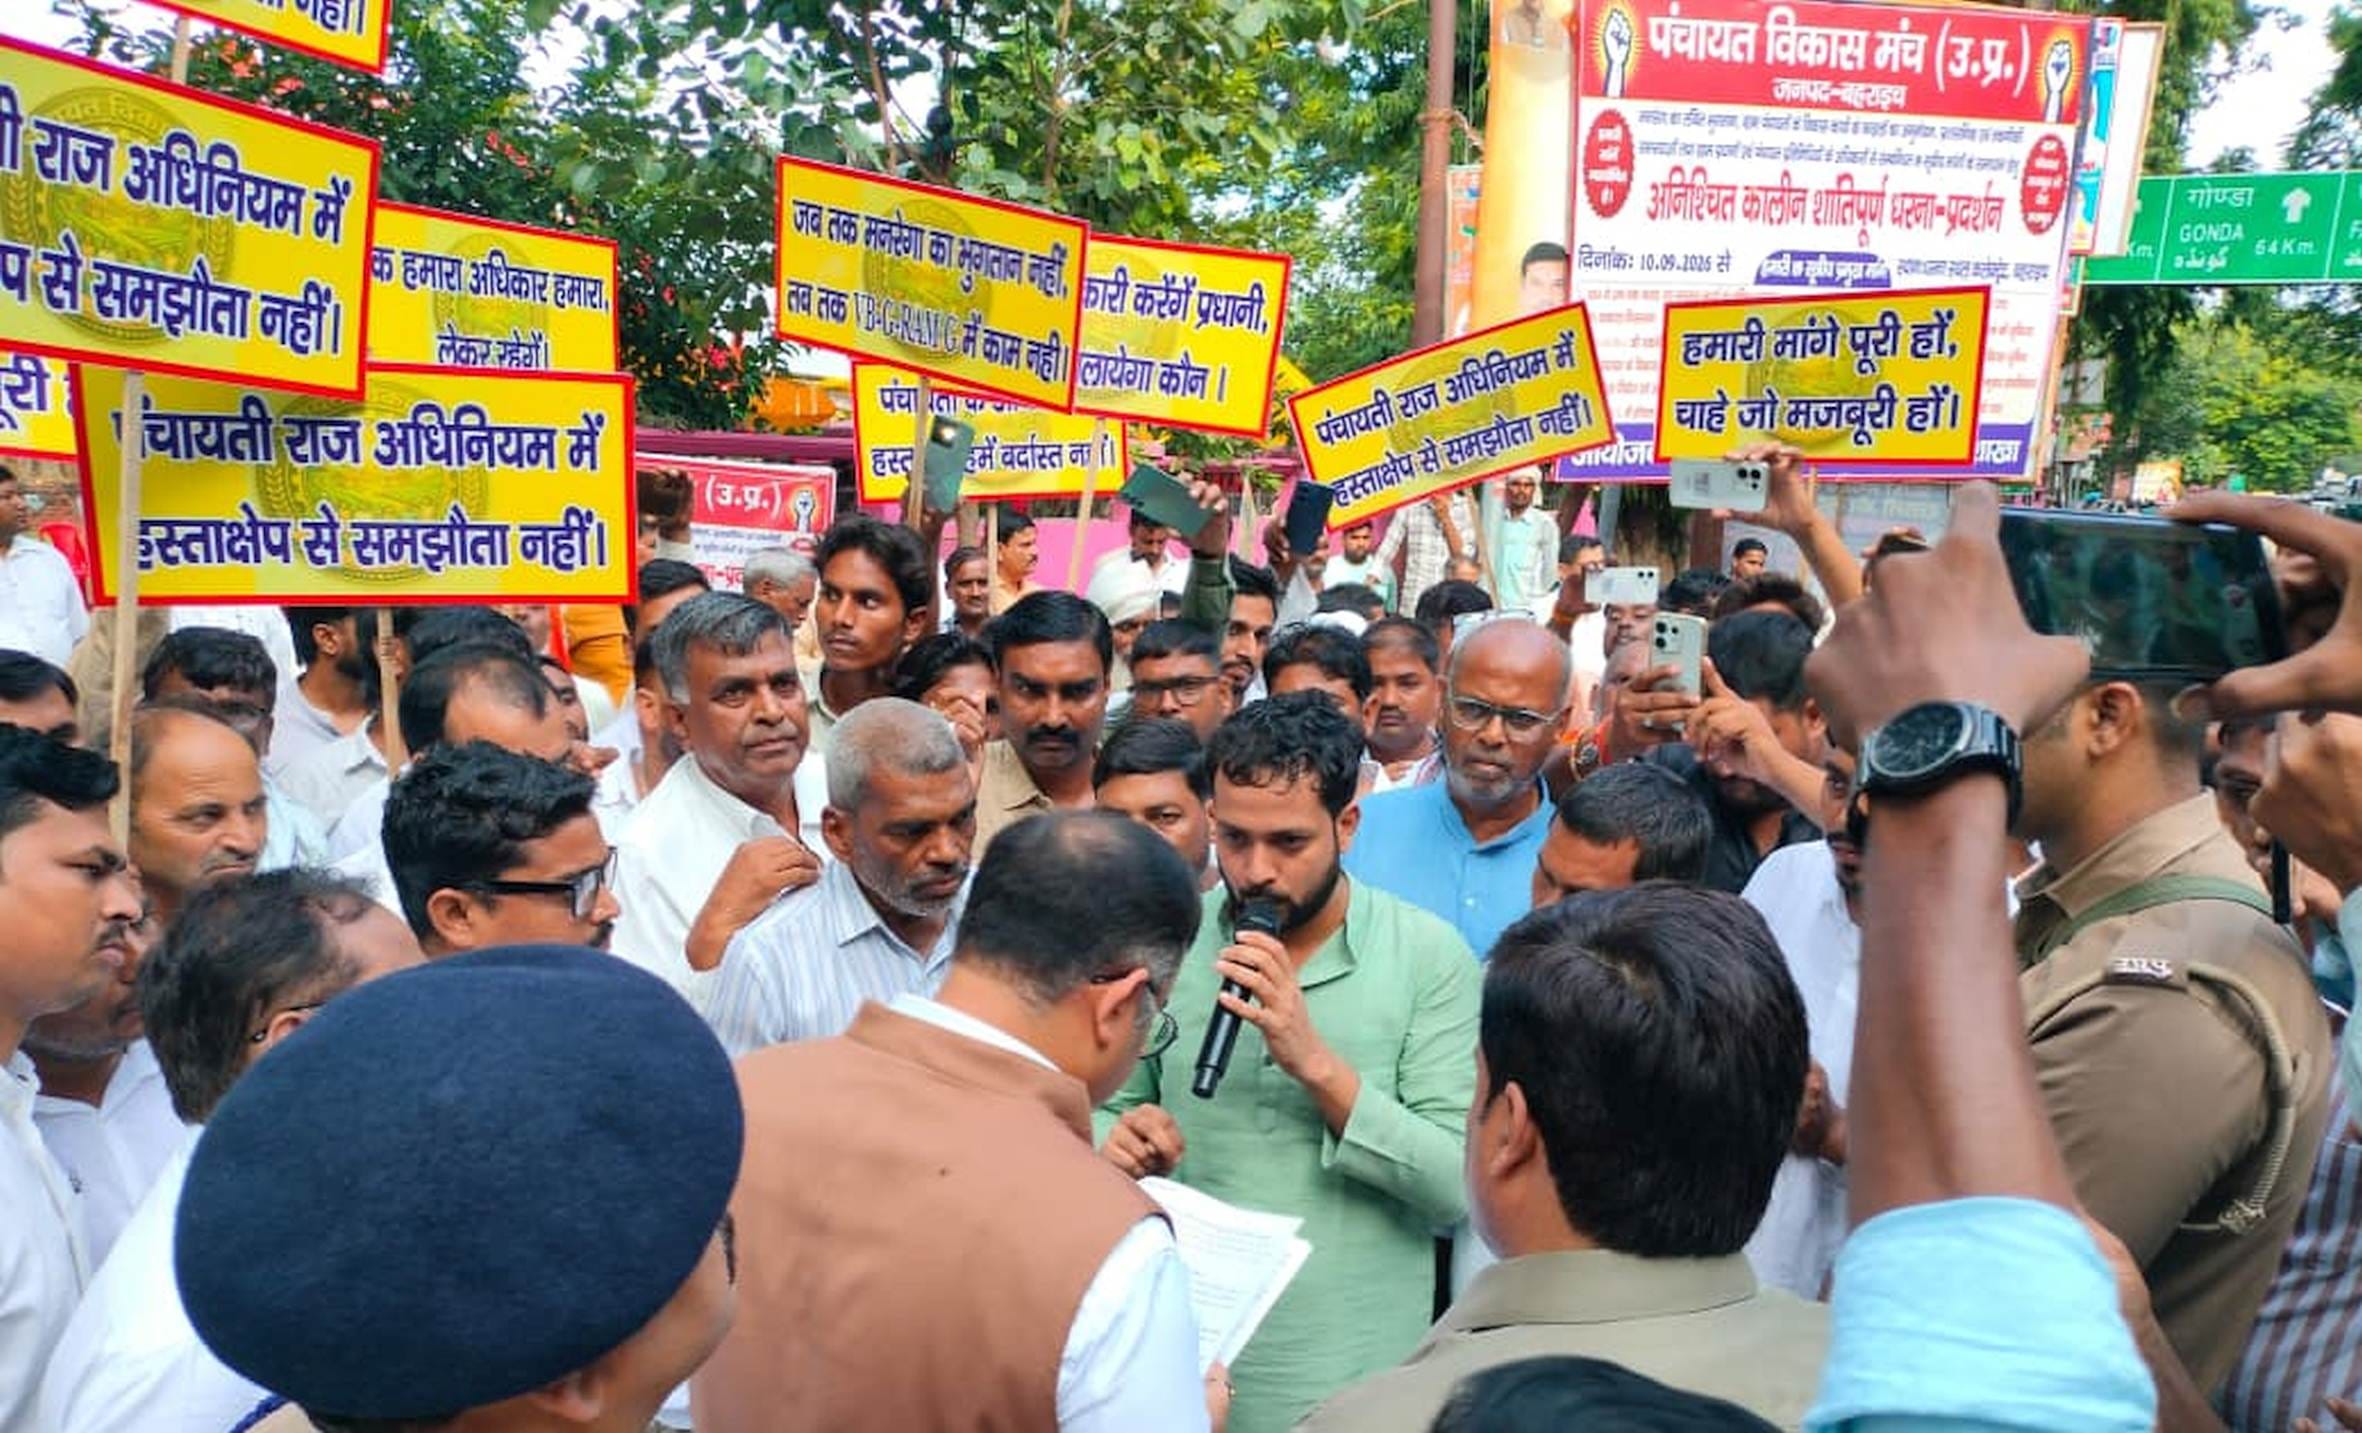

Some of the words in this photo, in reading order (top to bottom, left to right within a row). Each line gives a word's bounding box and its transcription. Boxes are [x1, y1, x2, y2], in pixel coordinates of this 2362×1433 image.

[1648, 1, 1758, 63] पंचायत
[1764, 6, 1869, 71] विकास
[1874, 17, 1929, 75] मंच
[1935, 18, 2030, 98] (उ.प्र.)
[35, 118, 114, 191] राज
[125, 131, 306, 236] अधिनियम
[314, 175, 350, 243] में
[1647, 165, 1738, 222] अनिश्चित
[1742, 169, 1808, 226] कालीन
[1890, 180, 2006, 238] धरना-प्रदर्शन
[2187, 181, 2255, 208] गोण्डा
[793, 201, 822, 237] जब
[828, 208, 857, 245] तक
[864, 208, 924, 261] मनरेगा
[930, 231, 953, 268] का
[958, 236, 1024, 293] भुगतान
[2180, 223, 2245, 242] GONDA
[42, 232, 82, 311] से
[93, 257, 250, 338] समझौता
[260, 280, 340, 354] नहीं।
[402, 250, 462, 292] हमारा
[469, 249, 549, 302] अधिकार
[437, 323, 492, 364] लेकर
[787, 279, 812, 315] तब
[818, 288, 848, 323] तक
[963, 312, 983, 358] में
[983, 327, 1022, 370] काम
[1683, 317, 1766, 365] हमारी
[1774, 315, 1840, 359] मांगे
[1849, 310, 1903, 374] पूरी
[1910, 309, 1957, 359] हों,
[1159, 350, 1209, 400] कौन
[1315, 388, 1395, 446] पंचायती
[1399, 383, 1439, 418] राज
[1445, 350, 1550, 402] अधिनियम
[1553, 331, 1576, 370] में
[283, 417, 362, 463] राज
[374, 402, 557, 470] अधिनियम
[566, 412, 605, 470] में
[1676, 388, 1729, 433] चाहे
[1737, 388, 1779, 429] जो
[1787, 384, 1898, 445] मजबूरी
[1906, 385, 1959, 432] हों।
[1332, 451, 1415, 507] हस्ताक्षेप
[1418, 438, 1440, 473] से
[1442, 414, 1534, 466] समझौता
[301, 503, 340, 565] से
[350, 503, 510, 572] समझौता
[519, 506, 606, 571] नहीं।
